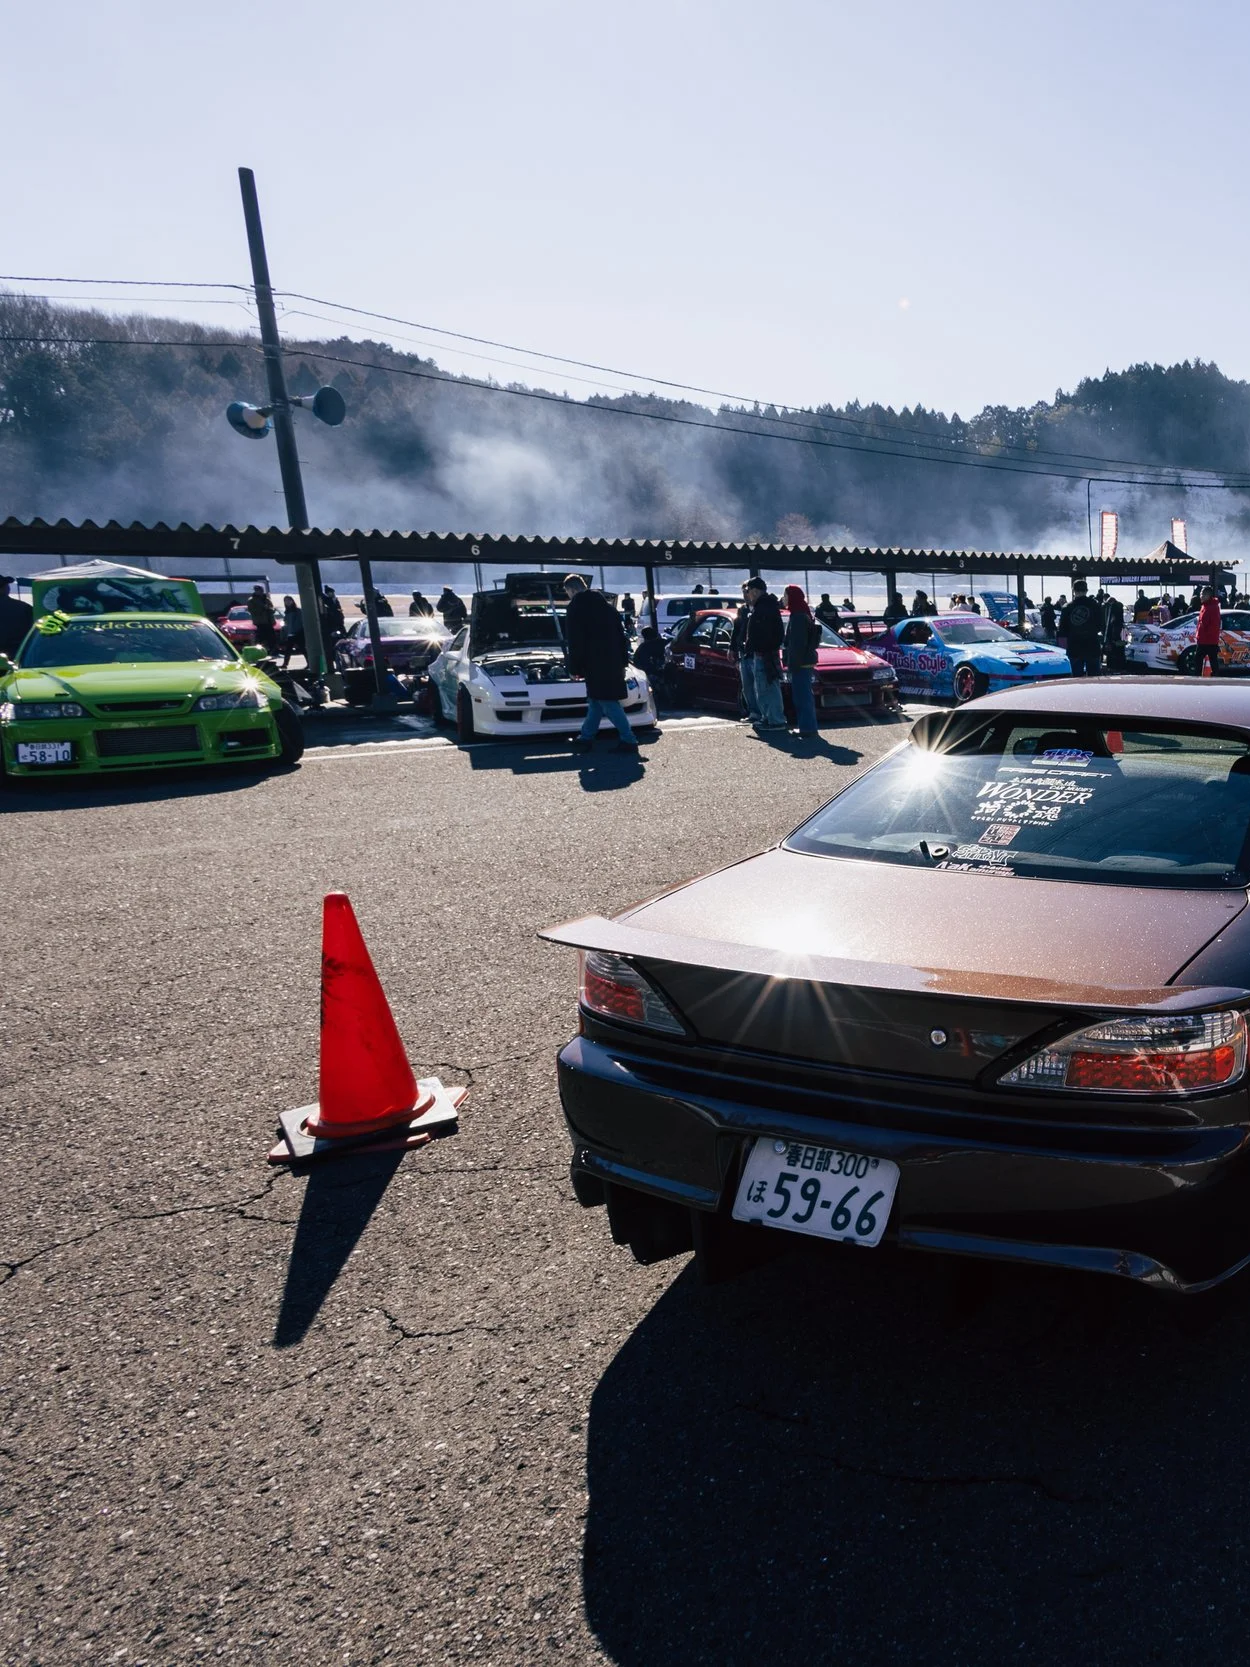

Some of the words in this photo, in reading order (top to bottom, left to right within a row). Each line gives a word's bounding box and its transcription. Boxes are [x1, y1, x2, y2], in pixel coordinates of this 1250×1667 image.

[230, 537, 240, 550] 7
[471, 545, 480, 556] 6
[665, 550, 672, 561] 5
[825, 556, 832, 566] 4
[959, 559, 965, 568] 3
[1072, 563, 1077, 571] 2
[30, 750, 70, 762] 58-10
[976, 781, 1093, 805] WONDER
[786, 1144, 869, 1179] 春日部300
[747, 1180, 768, 1203] ほ
[767, 1171, 885, 1236] 59-66
